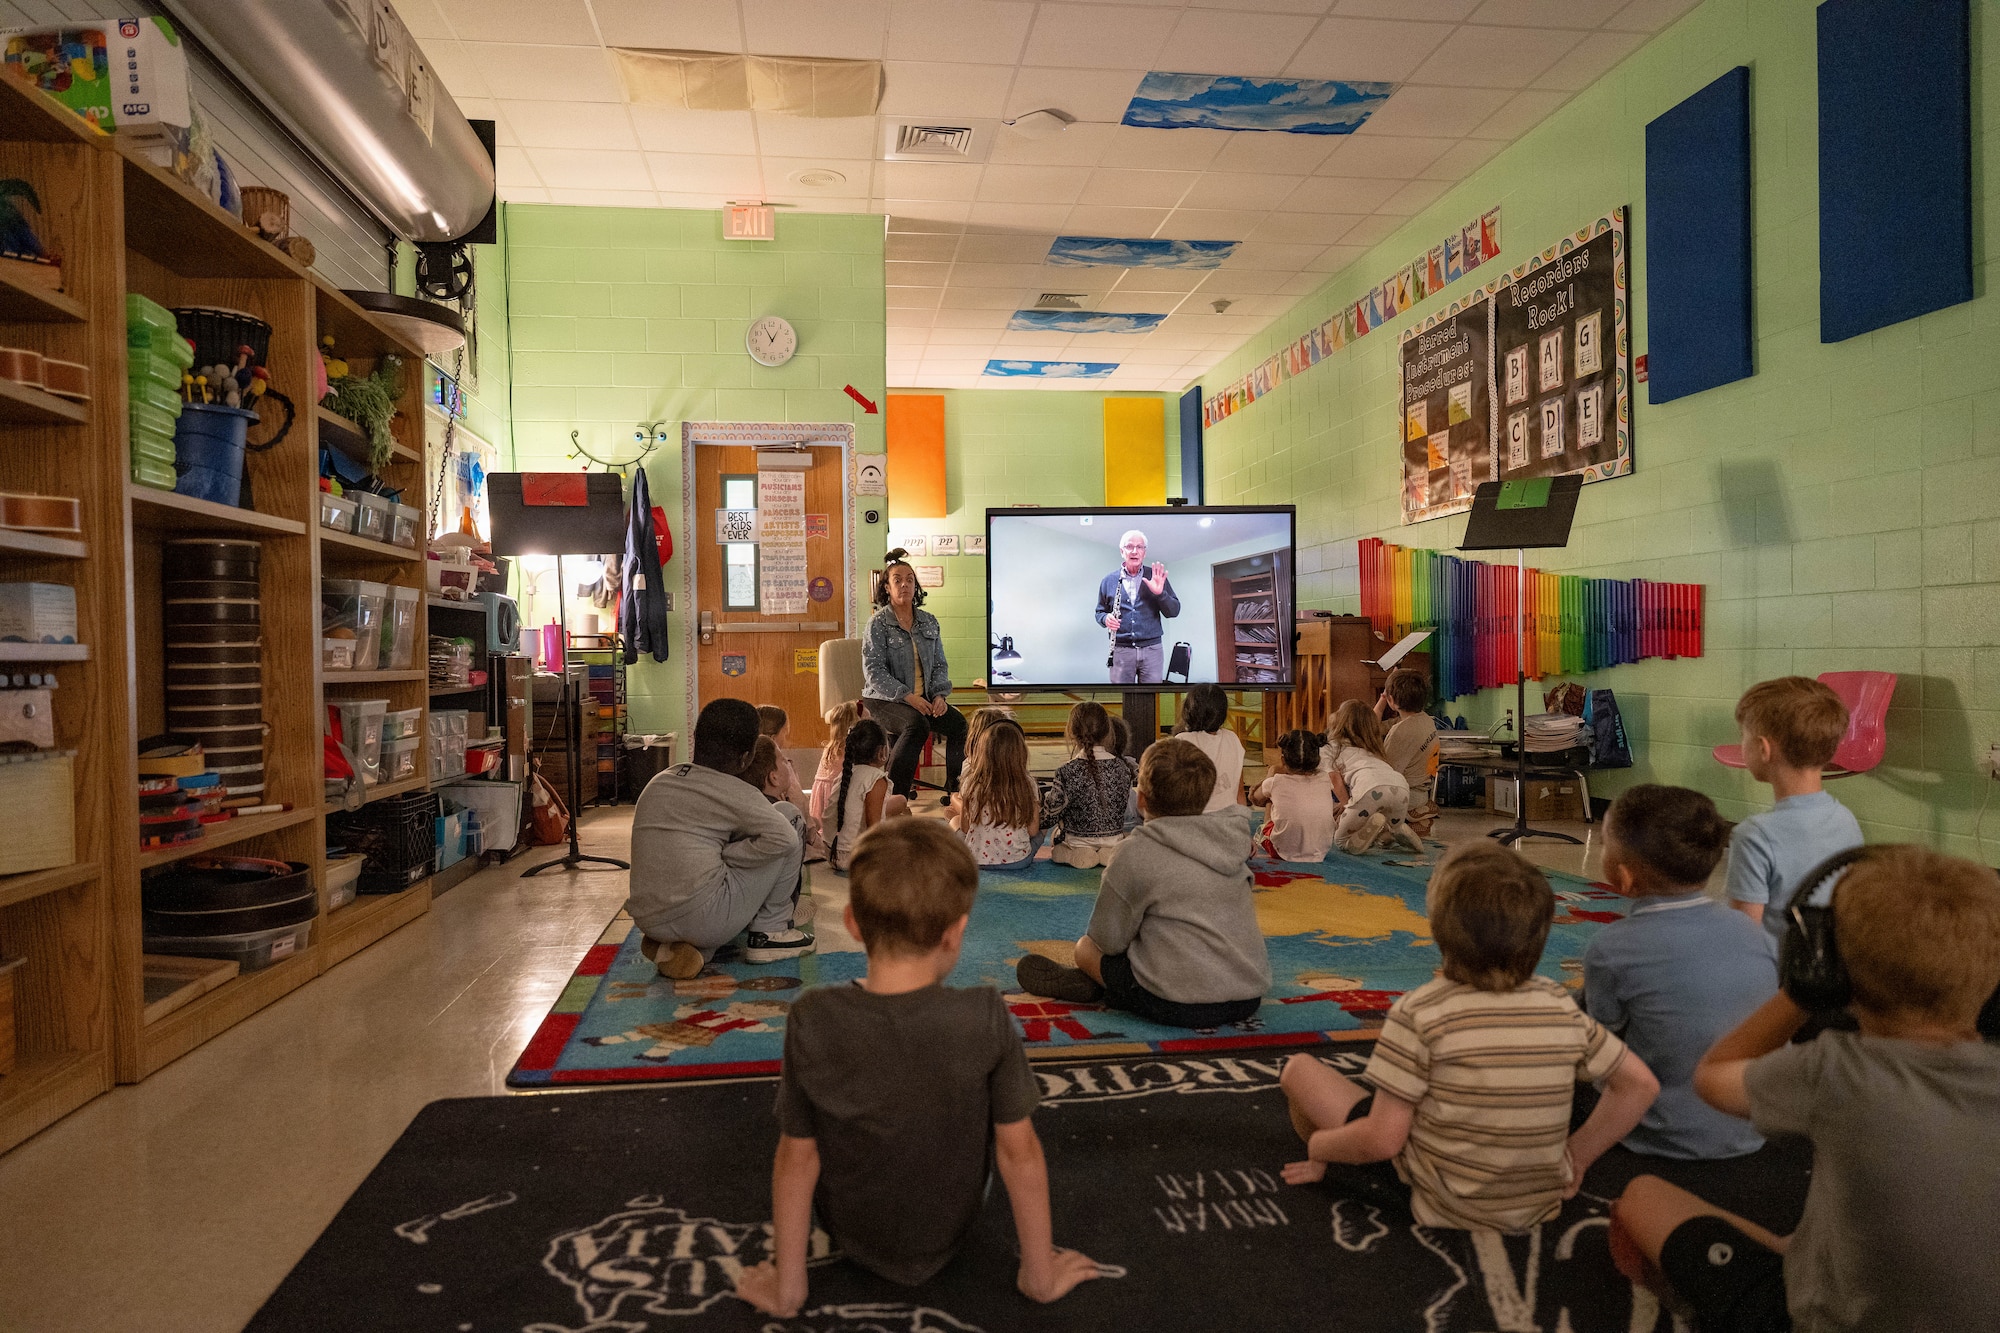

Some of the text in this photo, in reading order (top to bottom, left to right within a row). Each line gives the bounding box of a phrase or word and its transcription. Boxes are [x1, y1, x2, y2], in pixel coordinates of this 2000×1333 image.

[124, 104, 148, 114] DIY
[732, 208, 768, 236] EXIT
[1510, 248, 1590, 308] Recorders
[1528, 283, 1574, 330] Rock!
[1418, 316, 1457, 355] Barred
[1580, 324, 1588, 346] G
[1406, 332, 1470, 382] Instrument
[1544, 341, 1552, 364] A
[1511, 358, 1519, 378] B
[1406, 360, 1474, 403] Procedures:
[1583, 398, 1591, 419] E
[1546, 410, 1555, 431] D
[1512, 422, 1520, 442] C
[728, 512, 749, 522] BEST
[731, 521, 752, 531] KIDS
[728, 530, 749, 540] EVER
[904, 538, 924, 547] ppp
[939, 537, 953, 546] pp
[1614, 713, 1624, 748] aldi.us
[1154, 1198, 1290, 1233] INDIAN
